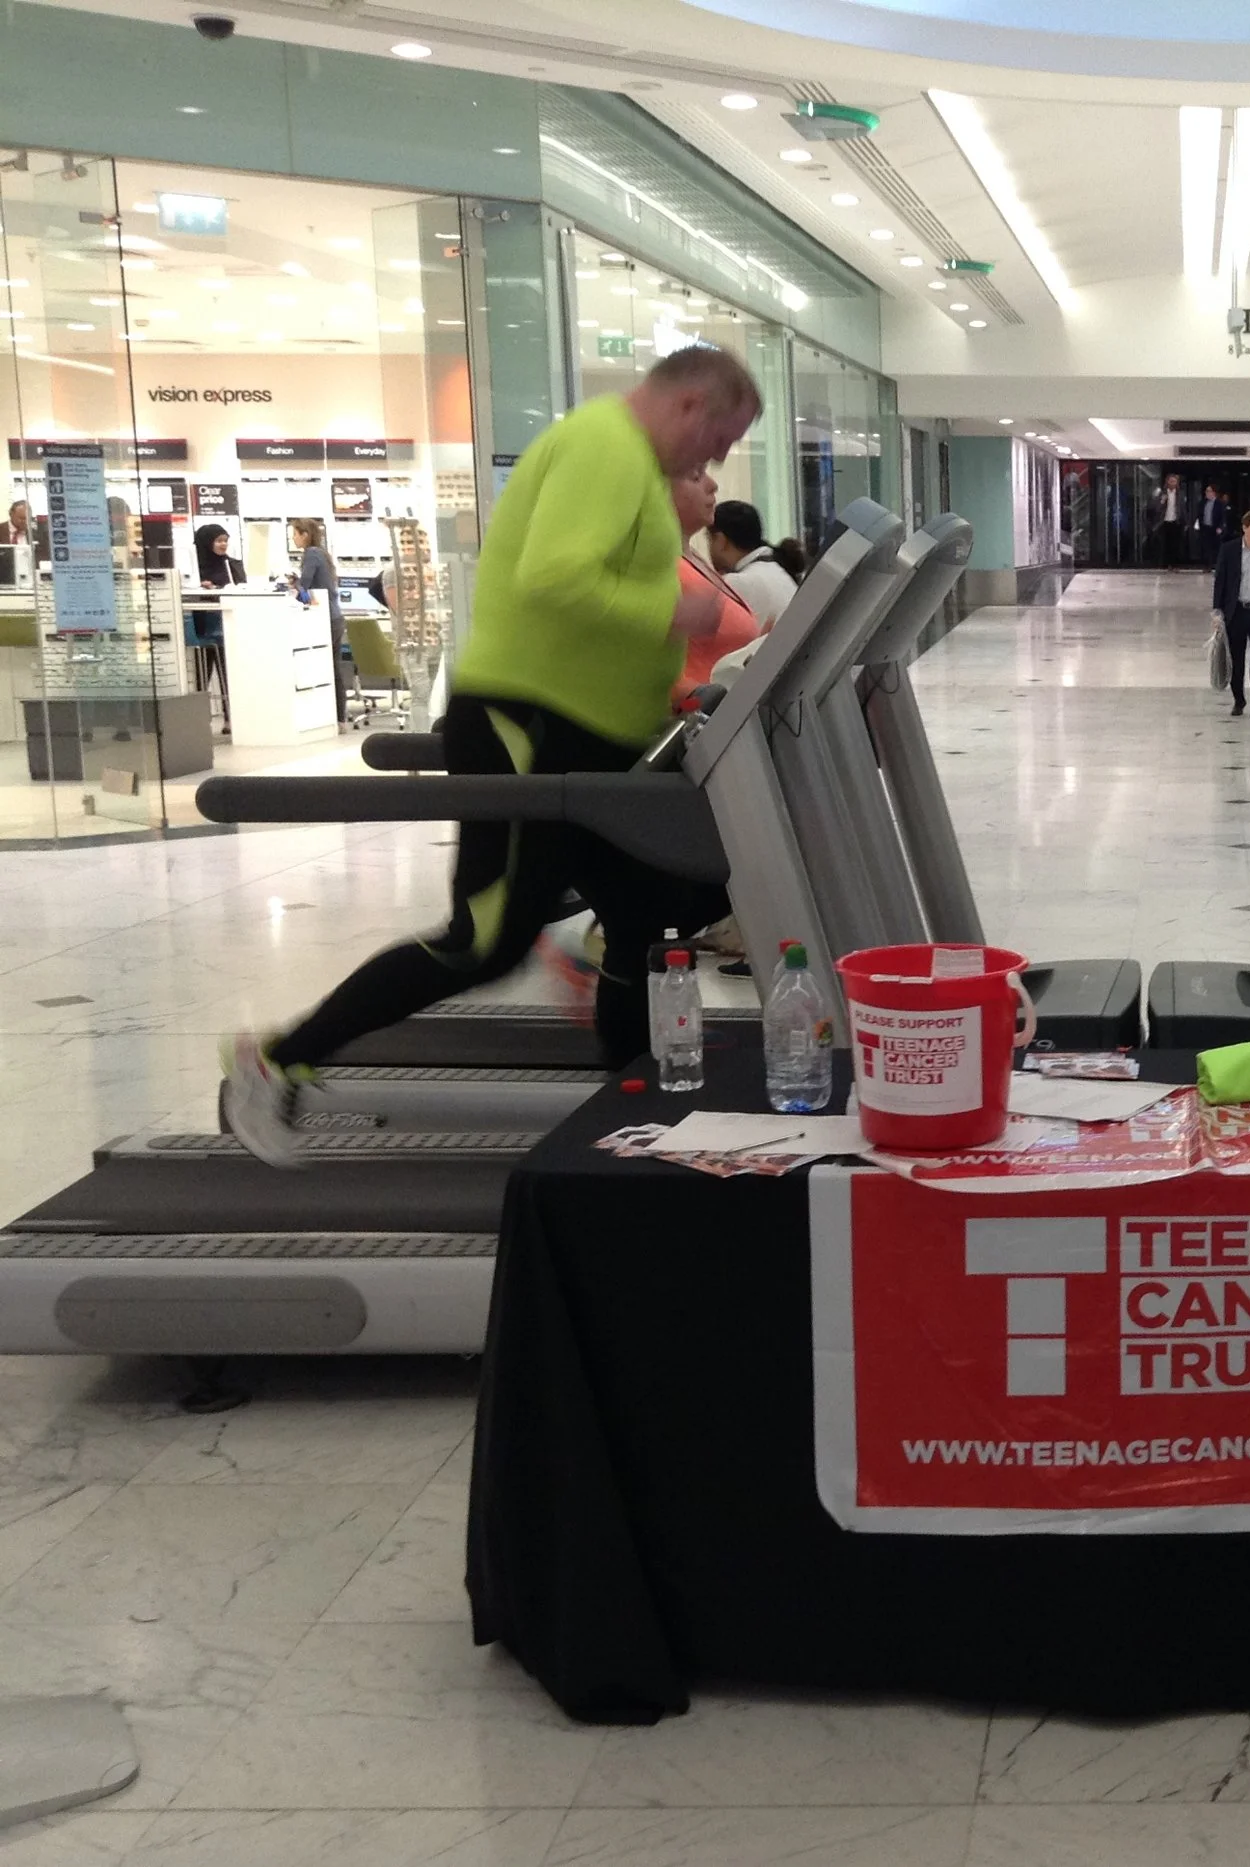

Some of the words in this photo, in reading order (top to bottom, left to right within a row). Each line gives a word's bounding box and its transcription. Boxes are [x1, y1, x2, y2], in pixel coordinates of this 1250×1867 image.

[148, 386, 199, 402] vision
[203, 387, 272, 405] express
[266, 446, 294, 456] Fashion
[354, 447, 386, 457] Everyday
[199, 495, 224, 505] price
[854, 1010, 895, 1028] PLEASE
[898, 1016, 964, 1029] SUPPORT
[884, 1036, 965, 1051] TEENAGE
[885, 1052, 958, 1068] CANCER
[885, 1069, 943, 1084] TRUST
